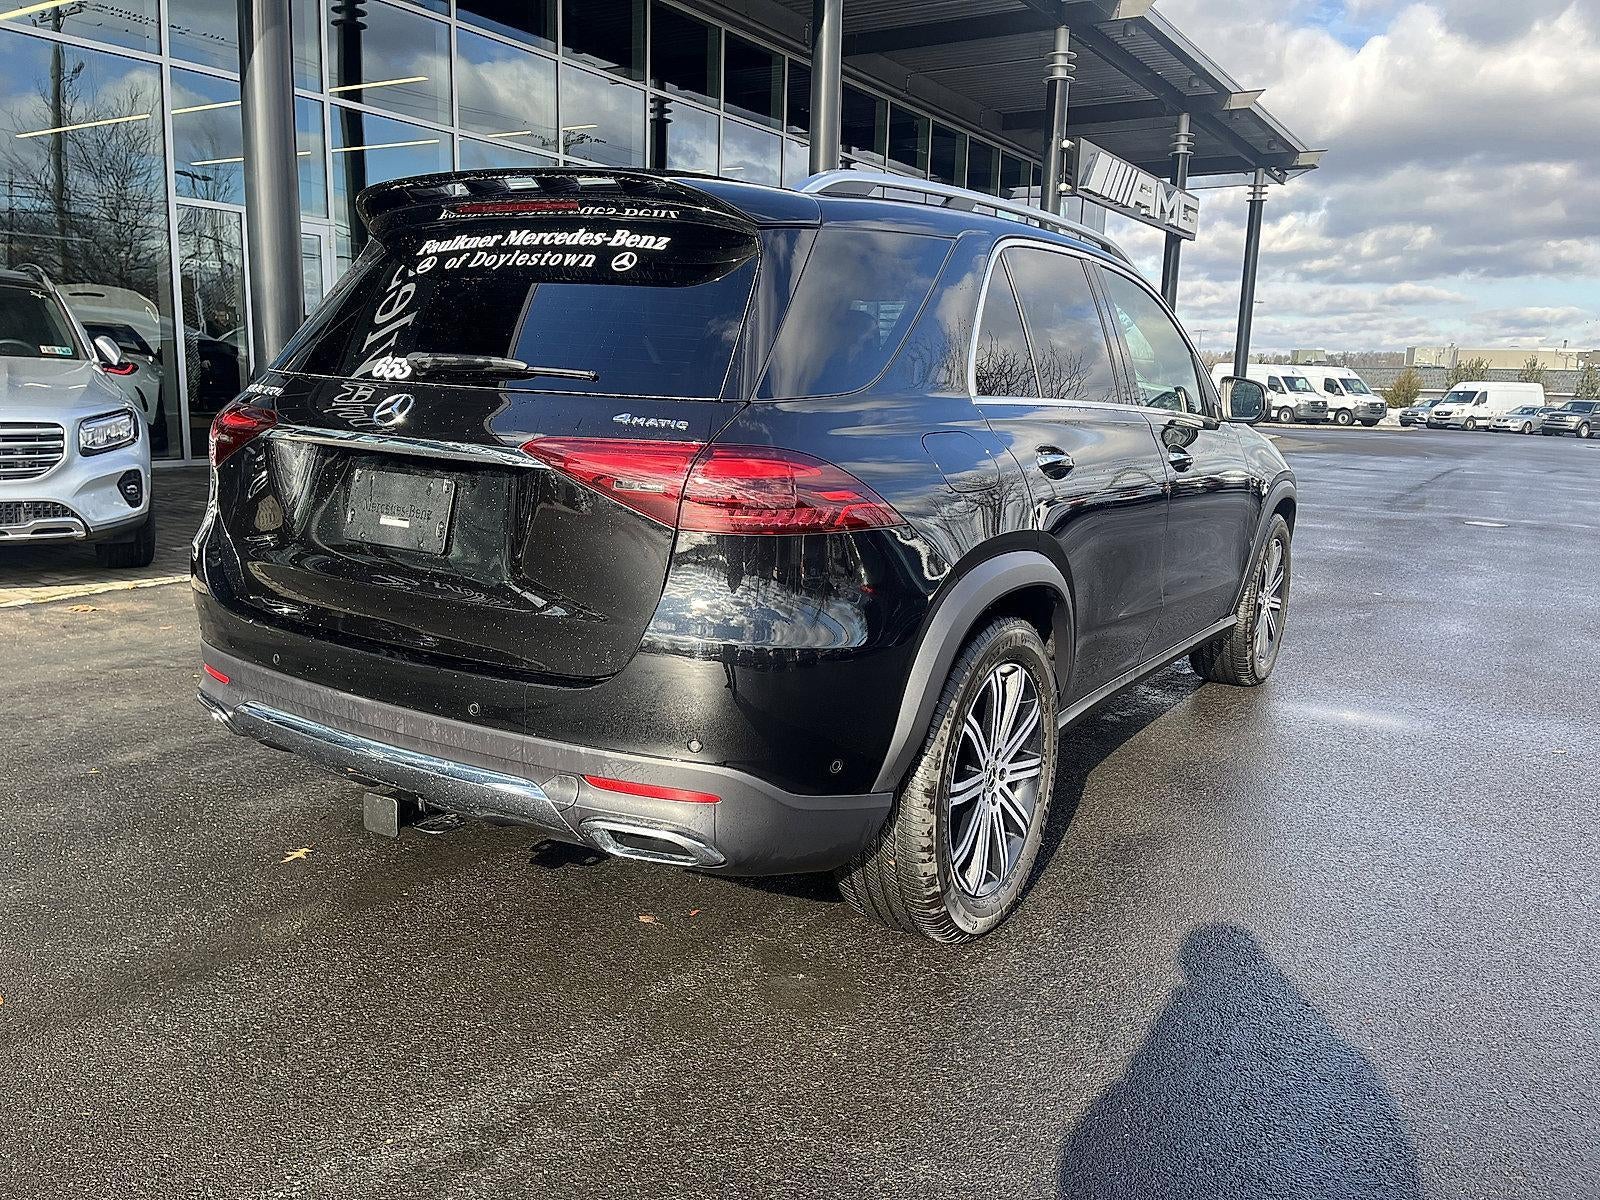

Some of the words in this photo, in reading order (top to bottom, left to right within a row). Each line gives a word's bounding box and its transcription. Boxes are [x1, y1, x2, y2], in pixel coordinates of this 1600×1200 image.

[416, 234, 503, 256] Faulkner
[501, 229, 671, 250] Mercedes-Benz
[444, 253, 470, 270] of
[468, 250, 596, 270] Doylestown
[362, 499, 433, 520] Mercedes-Benz
